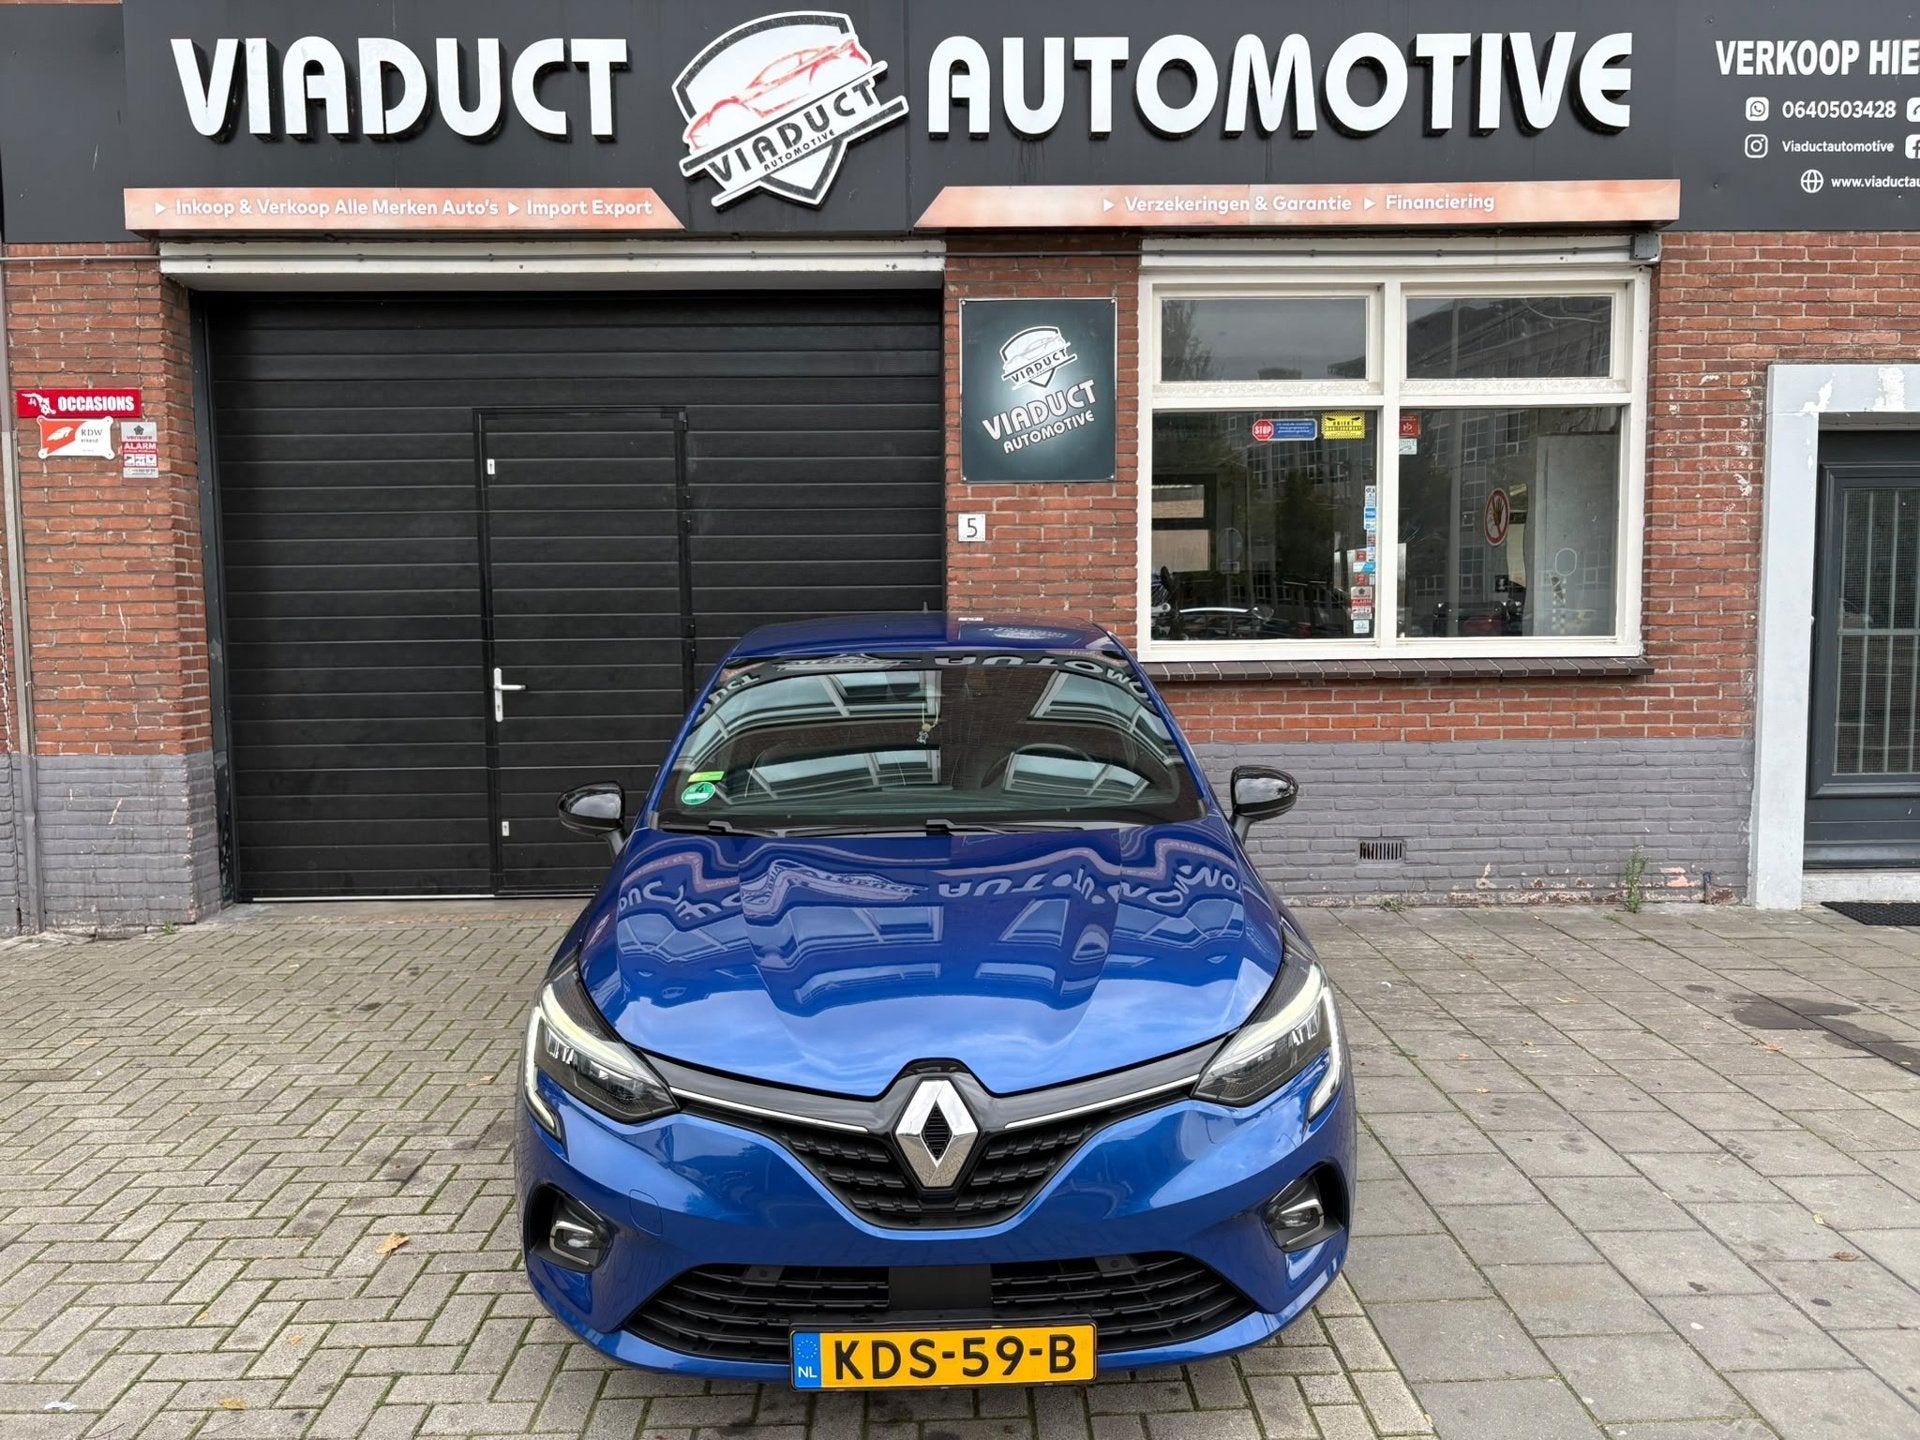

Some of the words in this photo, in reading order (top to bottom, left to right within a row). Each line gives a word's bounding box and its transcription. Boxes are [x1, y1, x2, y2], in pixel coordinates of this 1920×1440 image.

[1715, 40, 1860, 75] VERKOOP
[1869, 39, 1919, 75] HIE
[171, 36, 628, 136] VIADUCT
[928, 31, 1633, 134] AUTOMOTIVE
[1782, 100, 1896, 119] 0640503428
[708, 79, 875, 183] VIADUCT
[763, 128, 836, 172] AUTOMOTIVE
[1782, 140, 1894, 152] Viaductautomotive
[176, 198, 235, 217] Inkoop
[240, 199, 253, 214] &
[258, 199, 330, 217] Verkoop
[335, 199, 368, 214] Alle
[373, 199, 437, 215] Merken
[442, 200, 499, 215] Auto's
[527, 200, 588, 218] Import
[592, 200, 652, 218] Export
[1125, 196, 1250, 214] Verzekeringen
[1254, 197, 1268, 210] &
[1272, 195, 1352, 211] Garantie
[1385, 194, 1495, 212] Financiering
[1011, 348, 1067, 383] VIADUCT
[58, 396, 135, 412] OCCASIONS
[982, 379, 1097, 441] VIADUCT
[1003, 409, 1096, 454] AUTOMOTIVE
[1254, 425, 1272, 435] STOP
[124, 442, 157, 450] ALARM
[966, 518, 978, 538] 5
[834, 1334, 1076, 1380] KDS-59-B
[798, 1367, 818, 1378] NL
